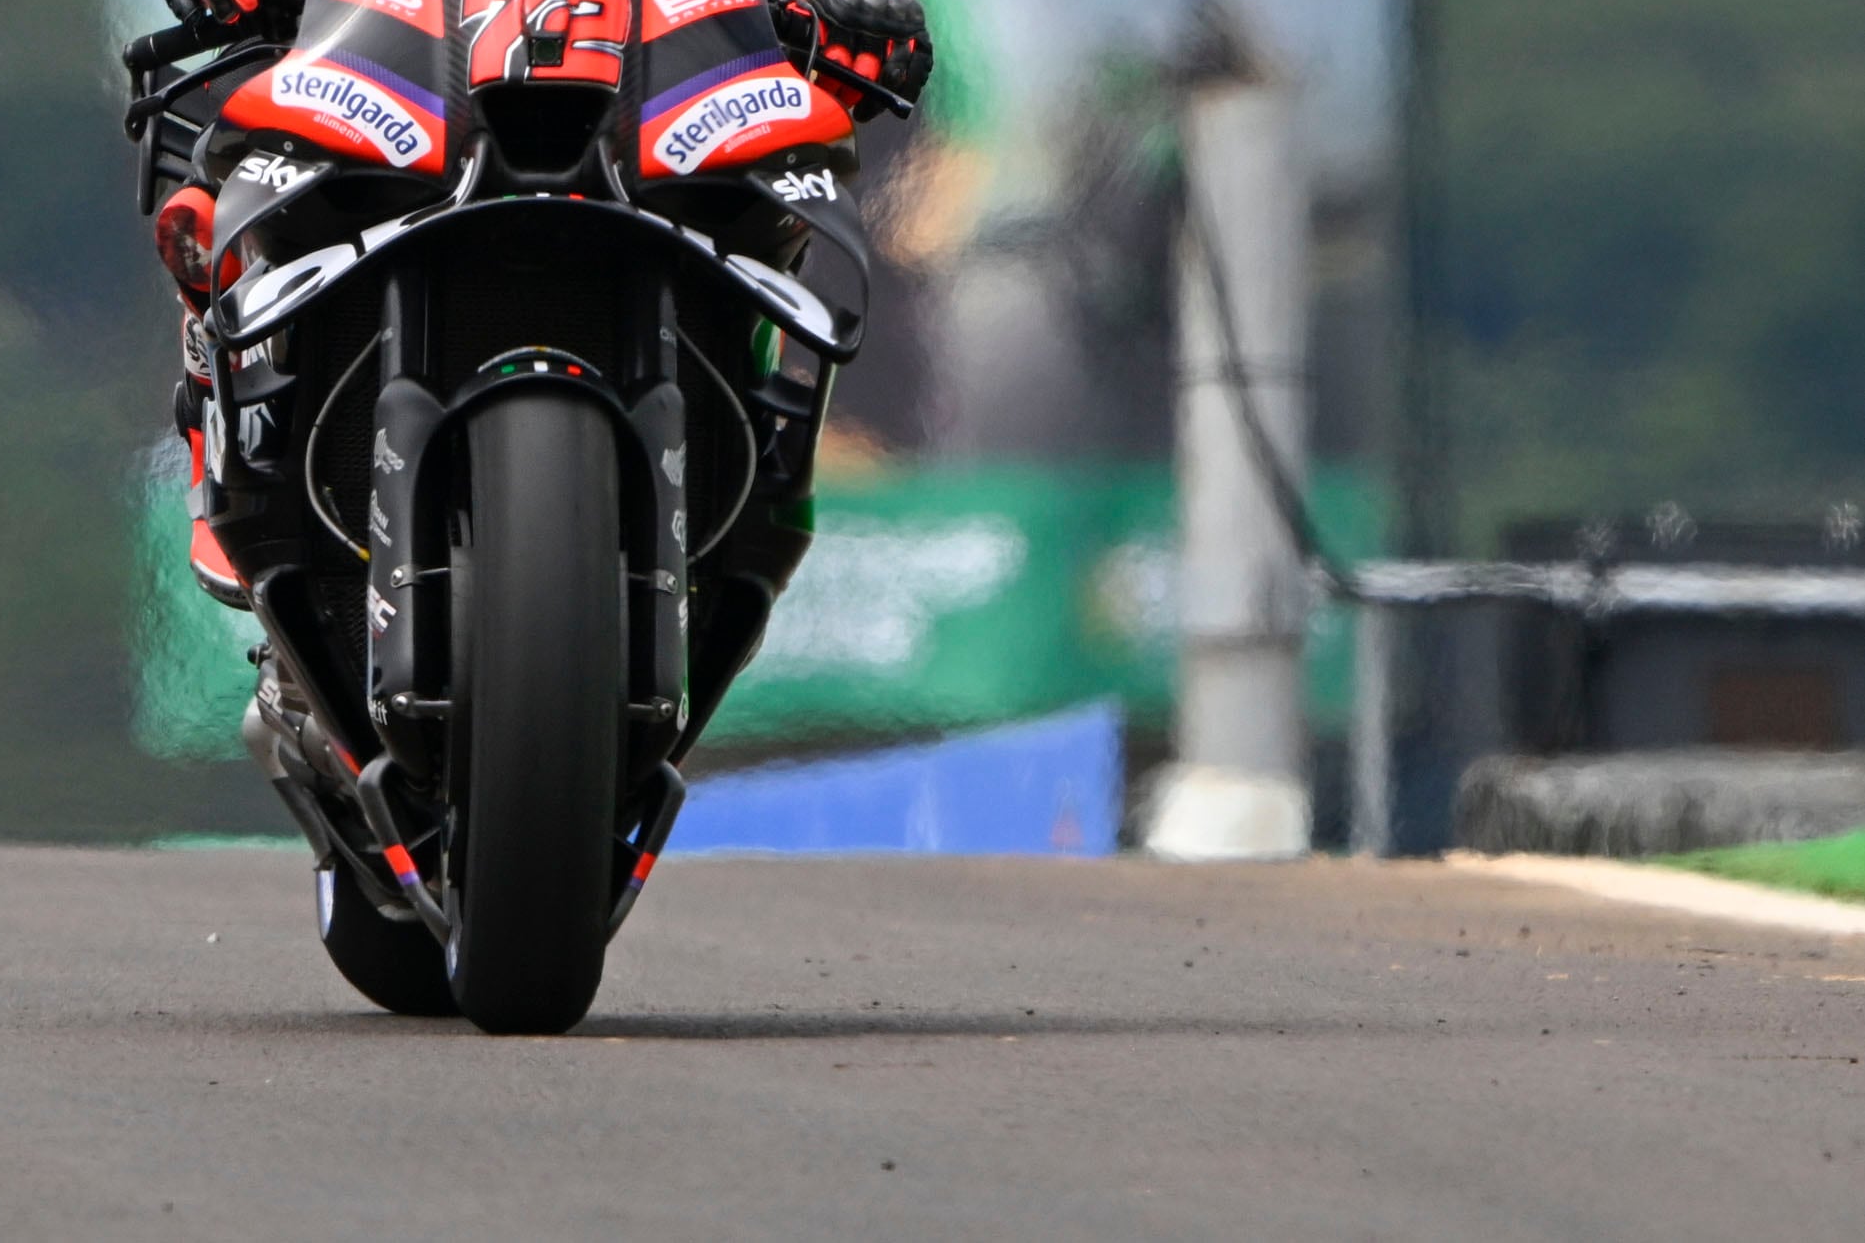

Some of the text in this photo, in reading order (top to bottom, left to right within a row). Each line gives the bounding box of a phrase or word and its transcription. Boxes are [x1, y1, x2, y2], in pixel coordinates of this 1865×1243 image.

[280, 71, 418, 156] sterilgarda
[313, 113, 363, 145] alimenti
[665, 79, 802, 164] sterilgarda
[724, 122, 771, 153] alimenti
[238, 156, 315, 193] sky
[772, 168, 837, 202] sky
